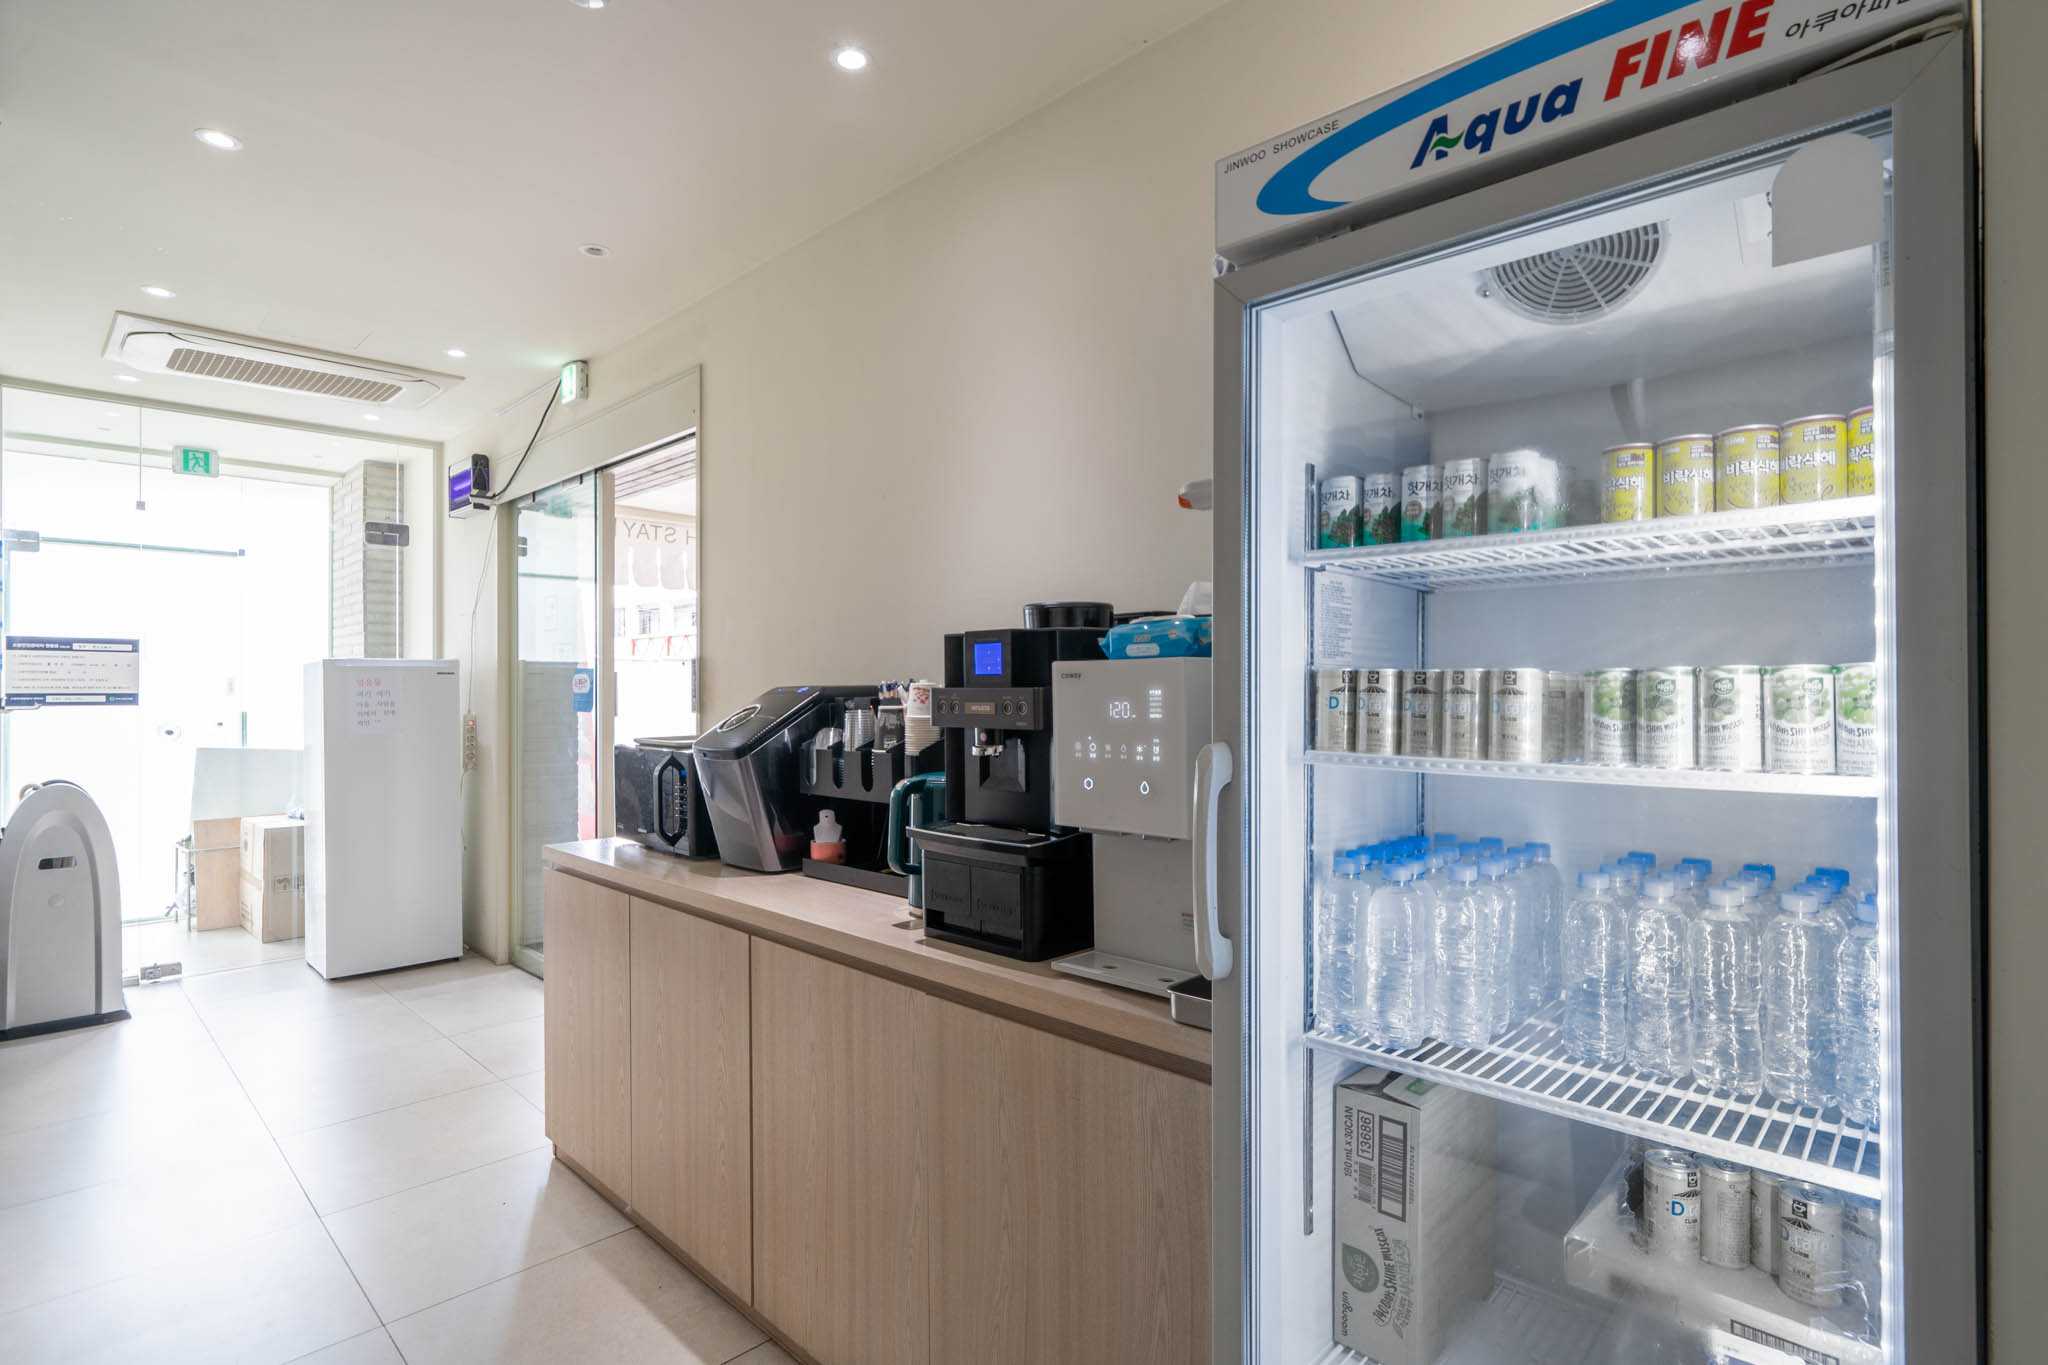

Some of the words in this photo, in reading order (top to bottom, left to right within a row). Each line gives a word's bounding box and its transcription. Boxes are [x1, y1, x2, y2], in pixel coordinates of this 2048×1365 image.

[1410, 77, 1583, 170] Aqua
[1603, 0, 1775, 102] FINE
[1224, 149, 1266, 174] JINWOO
[1272, 119, 1340, 155] SHOWCASE
[1360, 1116, 1372, 1155] 13686
[1341, 1290, 1359, 1337] woongjin
